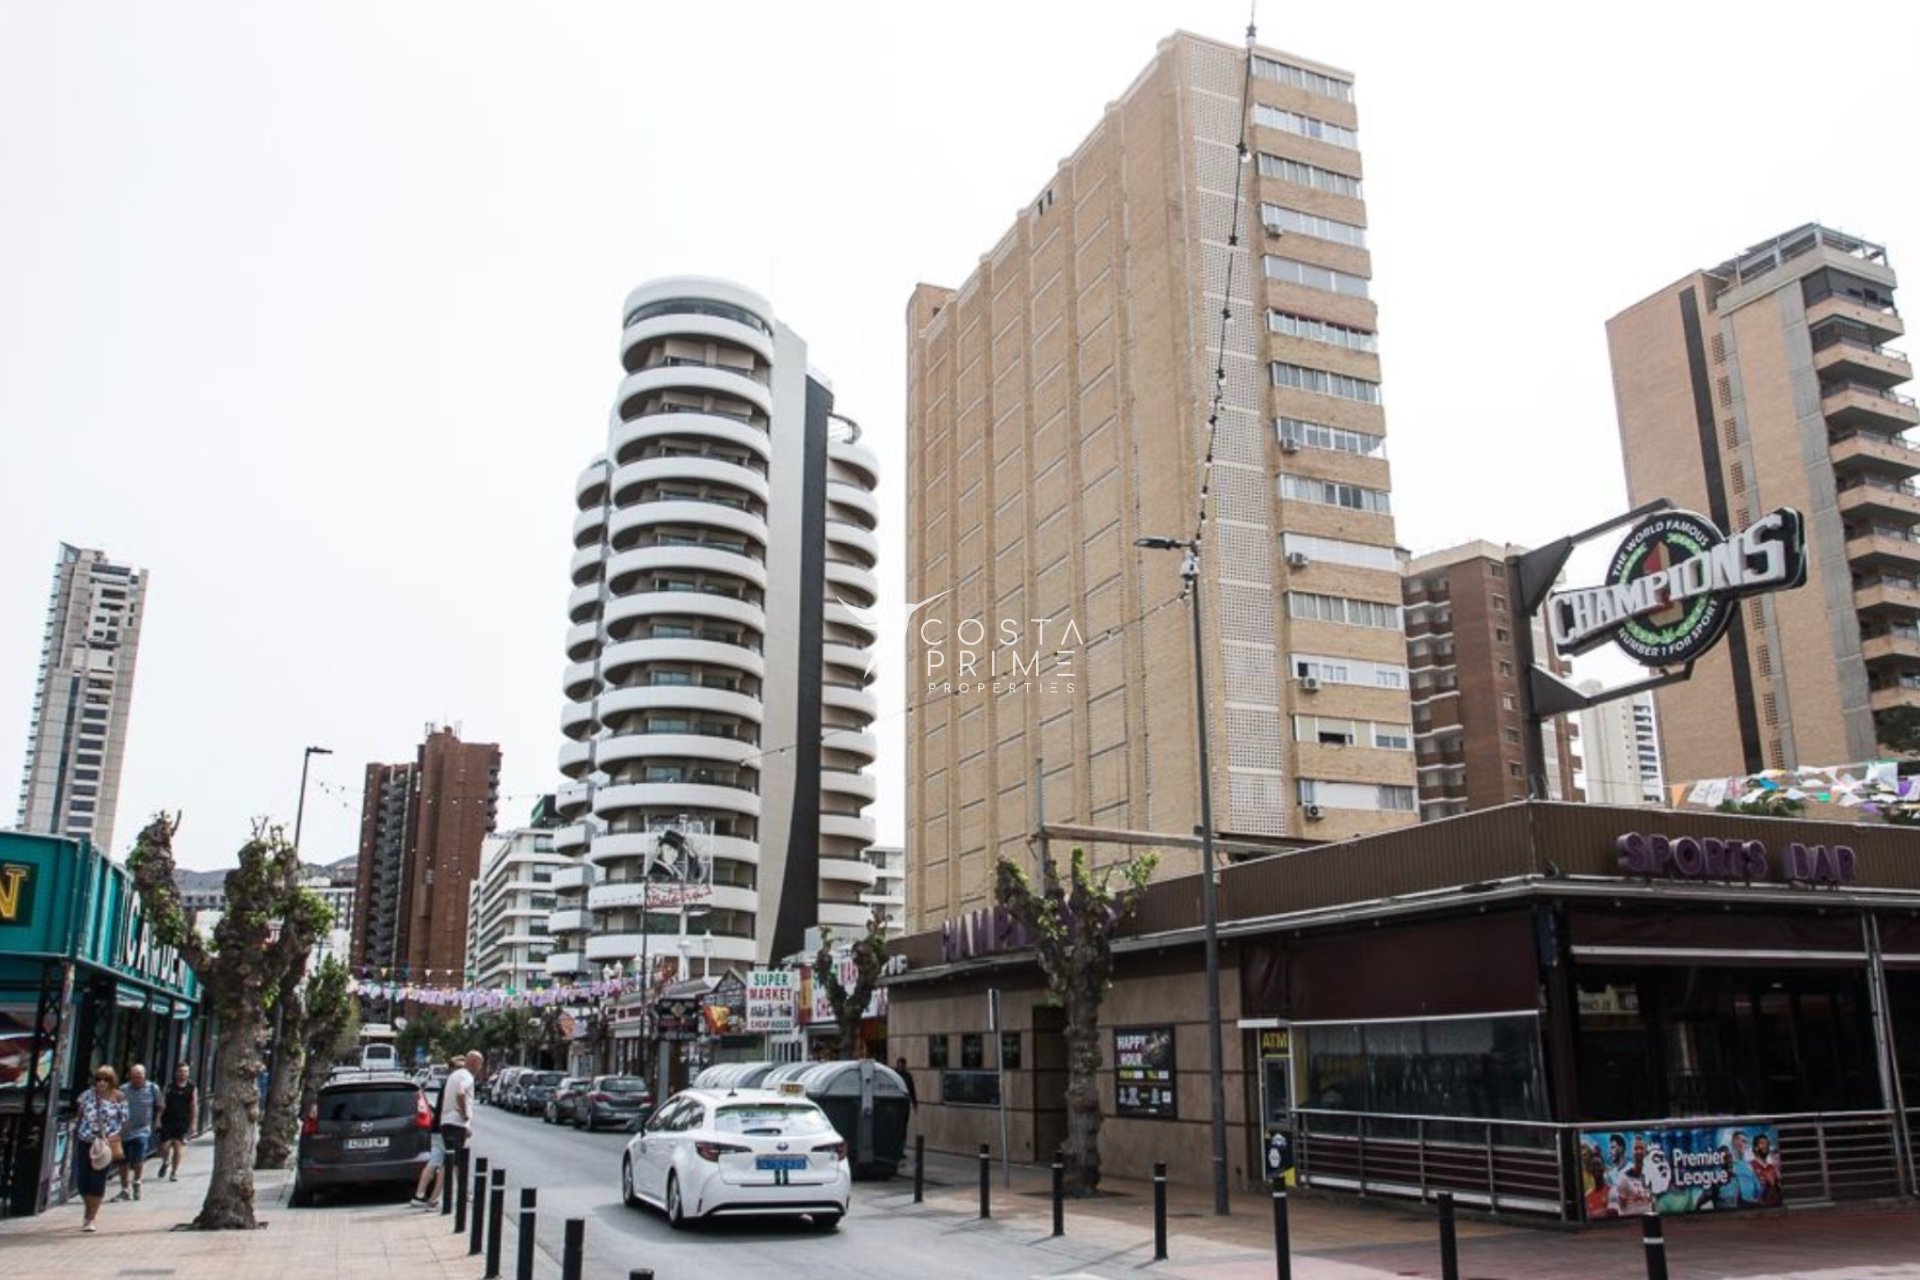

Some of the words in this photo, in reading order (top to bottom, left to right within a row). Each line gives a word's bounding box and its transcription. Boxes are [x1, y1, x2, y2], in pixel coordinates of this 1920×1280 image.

[1613, 553, 1626, 578] THE
[1626, 521, 1664, 551] WORLD
[1666, 519, 1709, 547] FAMOUS
[1548, 514, 1786, 646] CHAMPIONS
[1617, 627, 1658, 656] NUMBER
[1669, 637, 1692, 655] FOR
[1691, 600, 1719, 640] SPORT
[1617, 831, 1768, 879] SPORTS
[1783, 843, 1856, 881] BAR
[754, 973, 789, 986] SUPER
[749, 988, 793, 1001] MARKET
[1117, 1035, 1147, 1050] HAPPY
[1262, 1032, 1287, 1049] ATM
[1673, 1148, 1727, 1166] Premier
[1675, 1169, 1728, 1188] League
